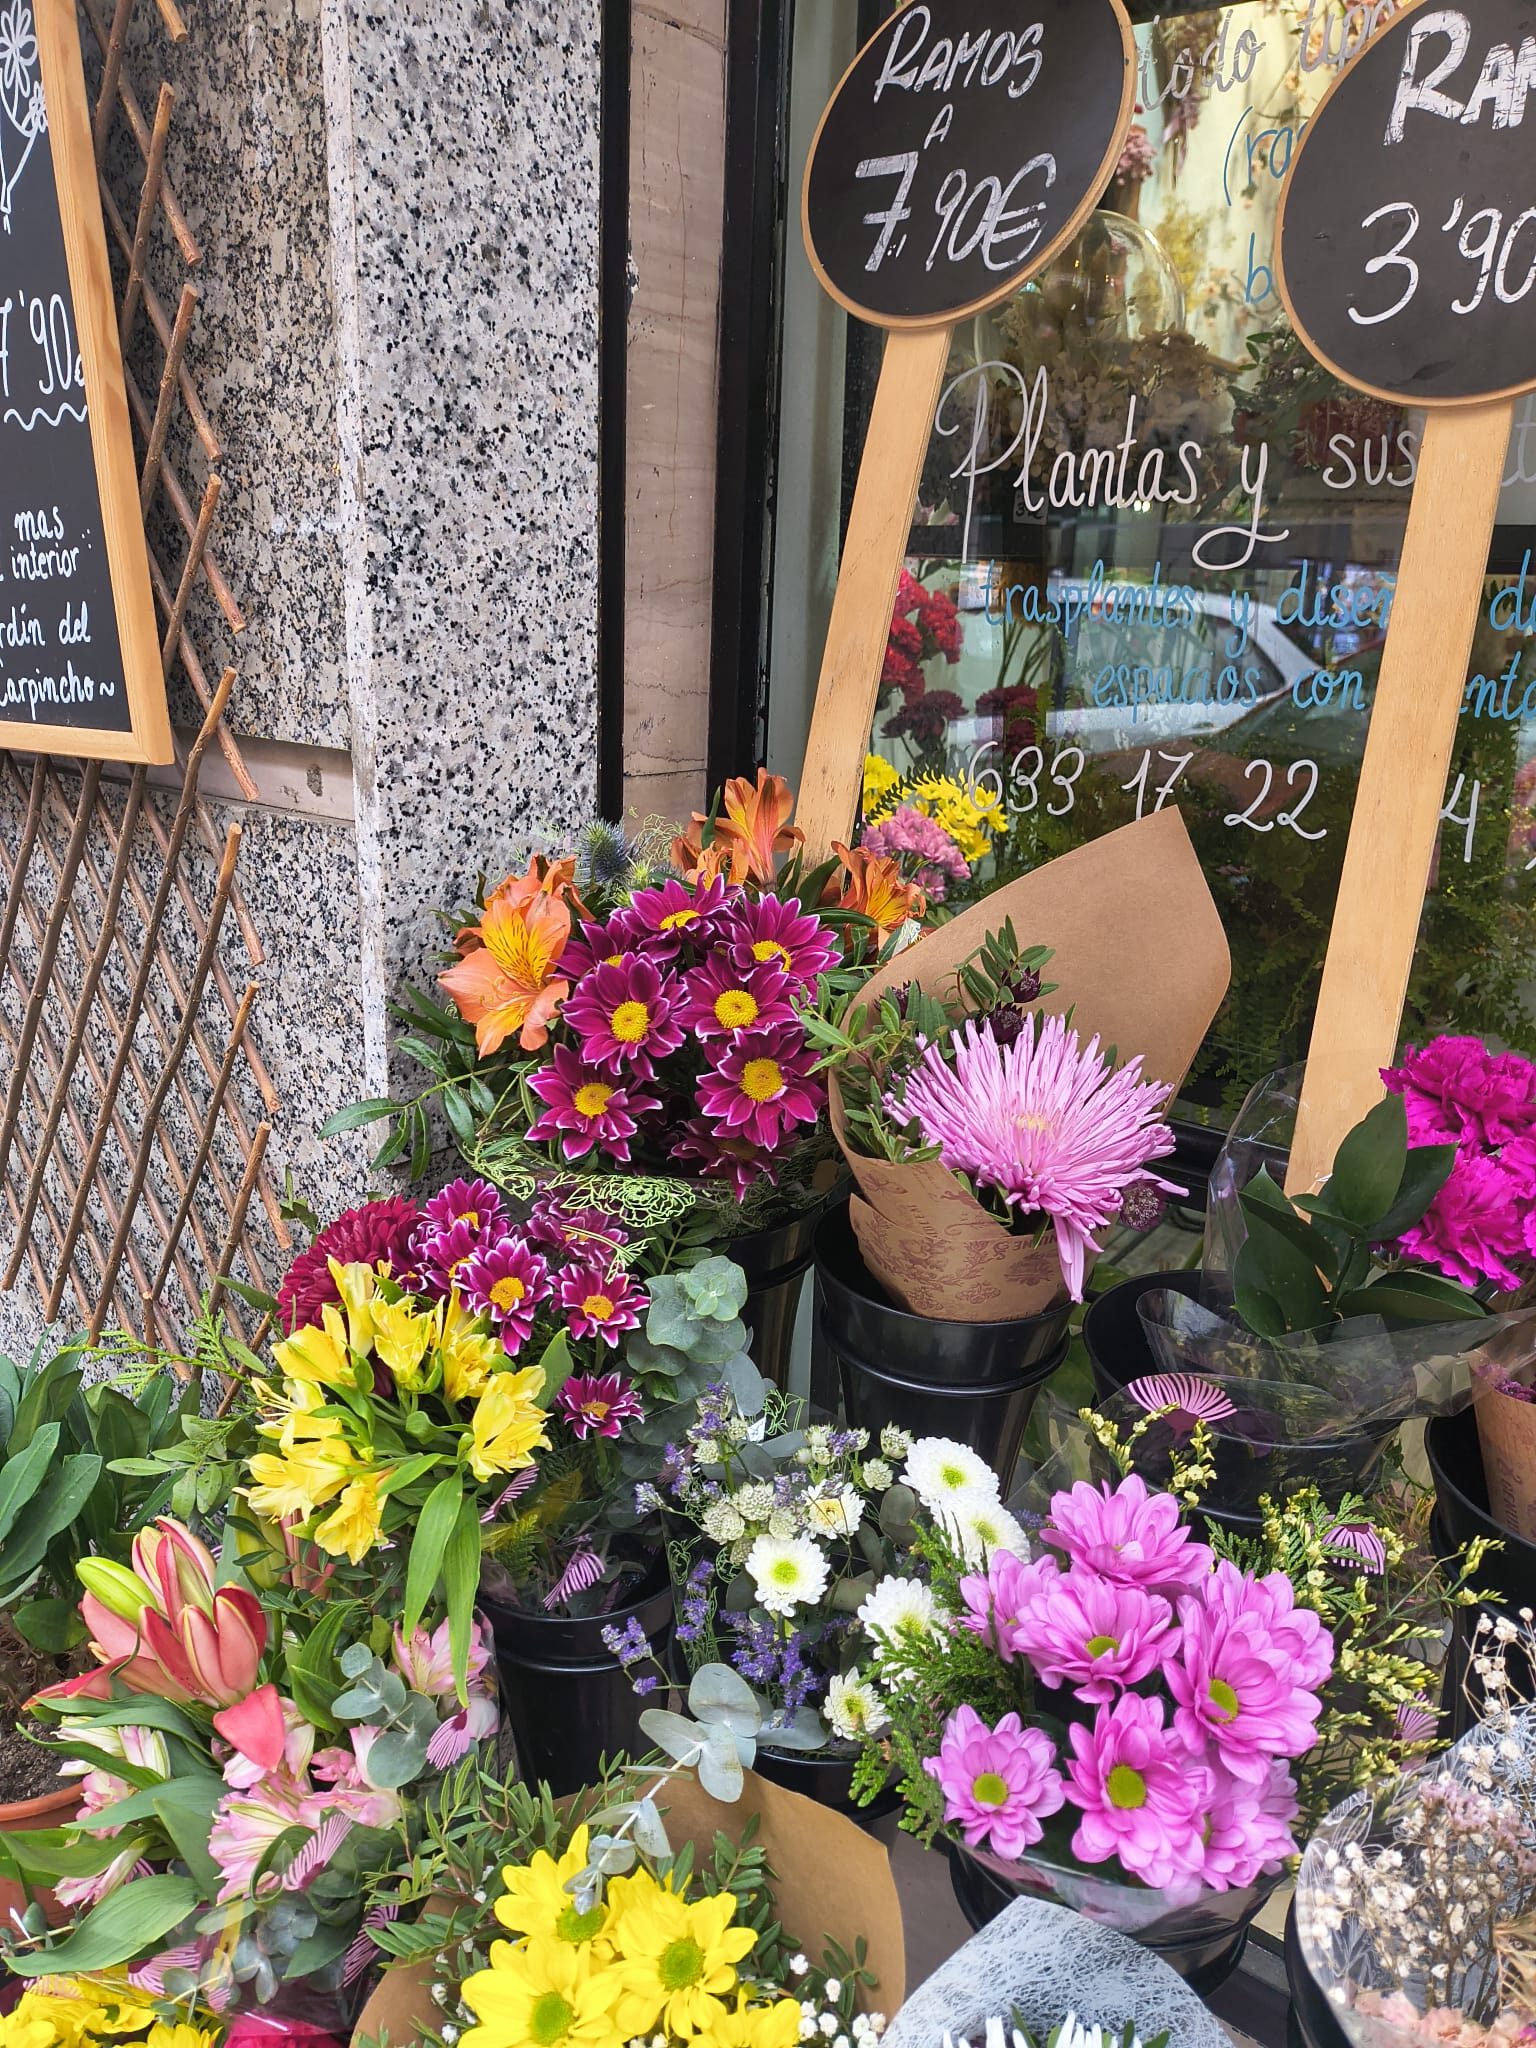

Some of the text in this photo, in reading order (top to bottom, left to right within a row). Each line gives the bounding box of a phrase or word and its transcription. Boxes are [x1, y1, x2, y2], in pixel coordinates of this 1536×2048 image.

[874, 5, 1044, 103] RAMOS
[923, 103, 953, 149] A
[855, 151, 1057, 272] 7,90€
[935, 360, 1201, 563] Plantas
[1191, 442, 1290, 570] y
[1323, 429, 1418, 488] sus
[10, 542, 79, 581] interior
[14, 506, 64, 541] mas
[58, 600, 91, 645] del
[979, 558, 1197, 638] trasplantes
[1225, 589, 1260, 659] y
[1091, 663, 1261, 724] espacios
[1292, 668, 1366, 711] con
[968, 741, 1085, 816] 633
[1121, 748, 1194, 821] 17
[1223, 758, 1328, 840] 22
